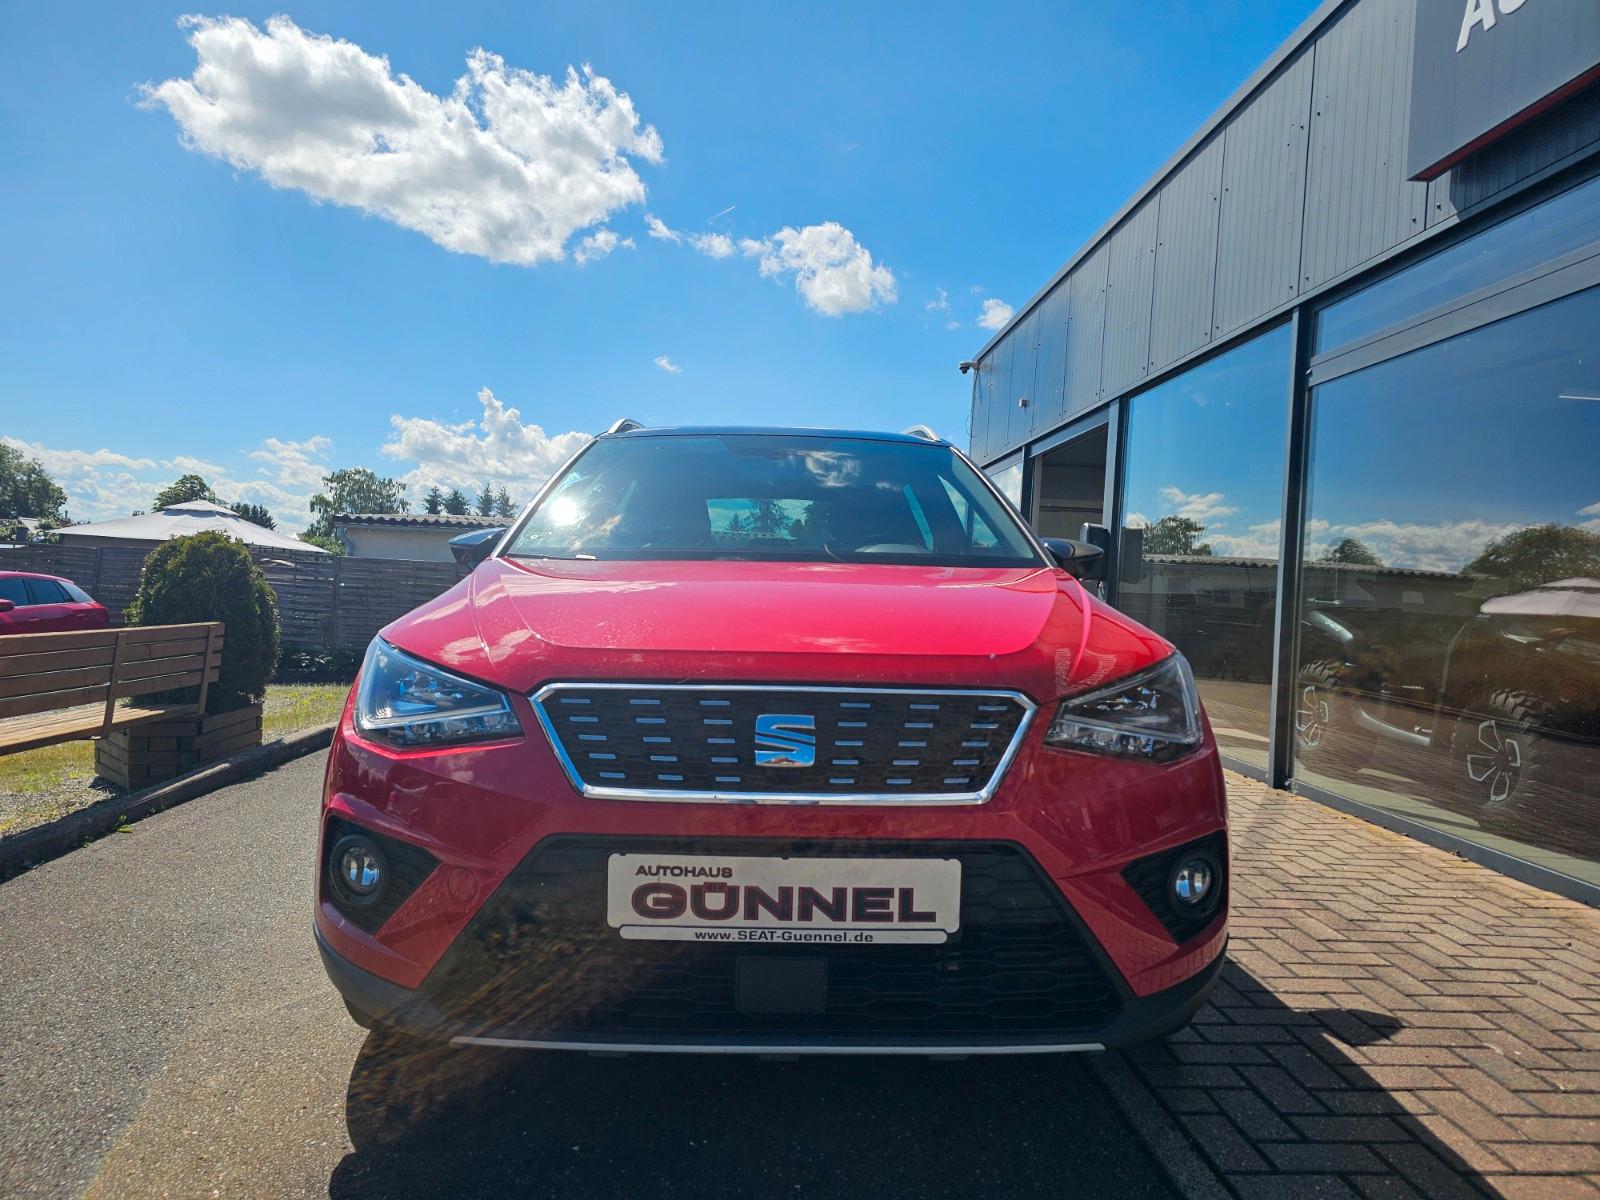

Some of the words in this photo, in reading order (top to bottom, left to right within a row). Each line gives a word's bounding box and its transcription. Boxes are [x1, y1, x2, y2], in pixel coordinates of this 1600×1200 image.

[635, 865, 733, 878] AUTOHAUS
[631, 882, 937, 922] GÜNNEL
[694, 930, 874, 943] www.SEAT-Guennel.de
